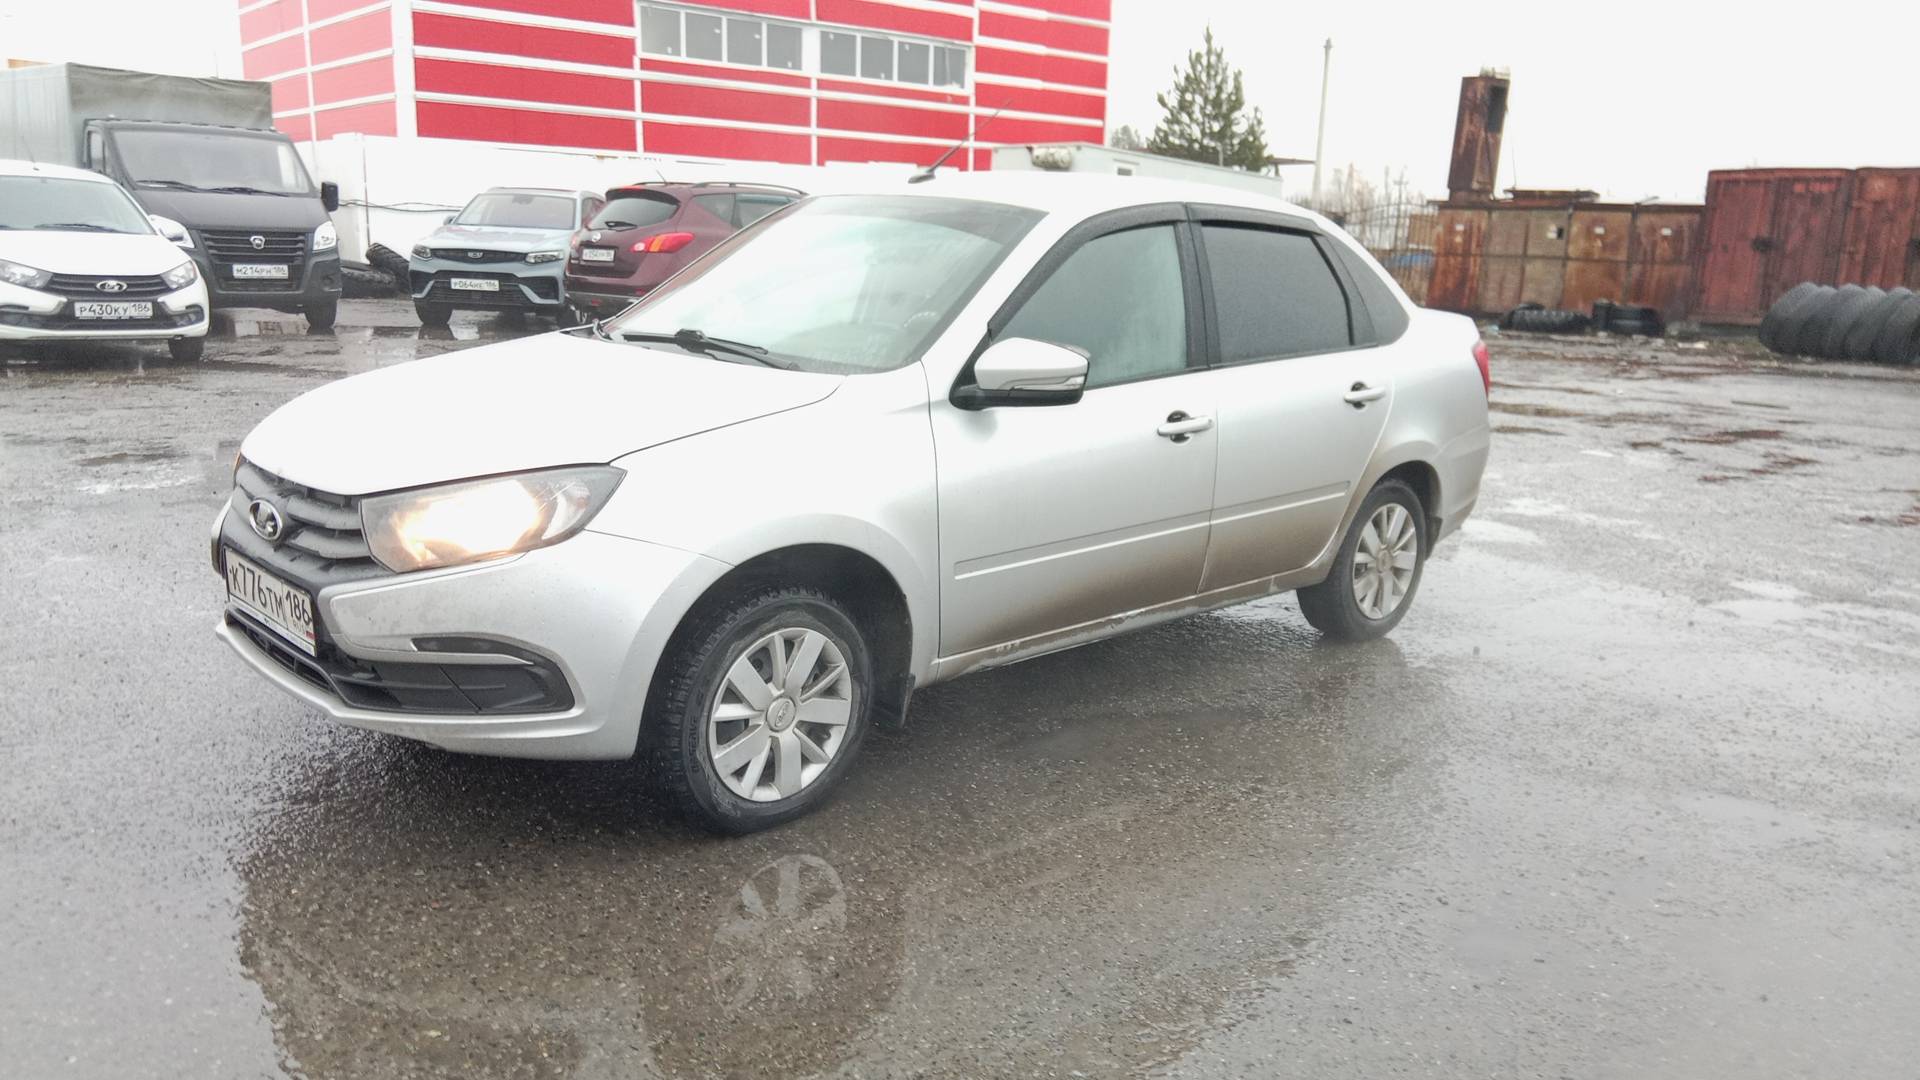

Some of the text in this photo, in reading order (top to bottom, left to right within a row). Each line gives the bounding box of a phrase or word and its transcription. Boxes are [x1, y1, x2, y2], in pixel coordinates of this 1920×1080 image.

[79, 303, 150, 316] Р430КУ 186
[286, 590, 311, 627] 186
